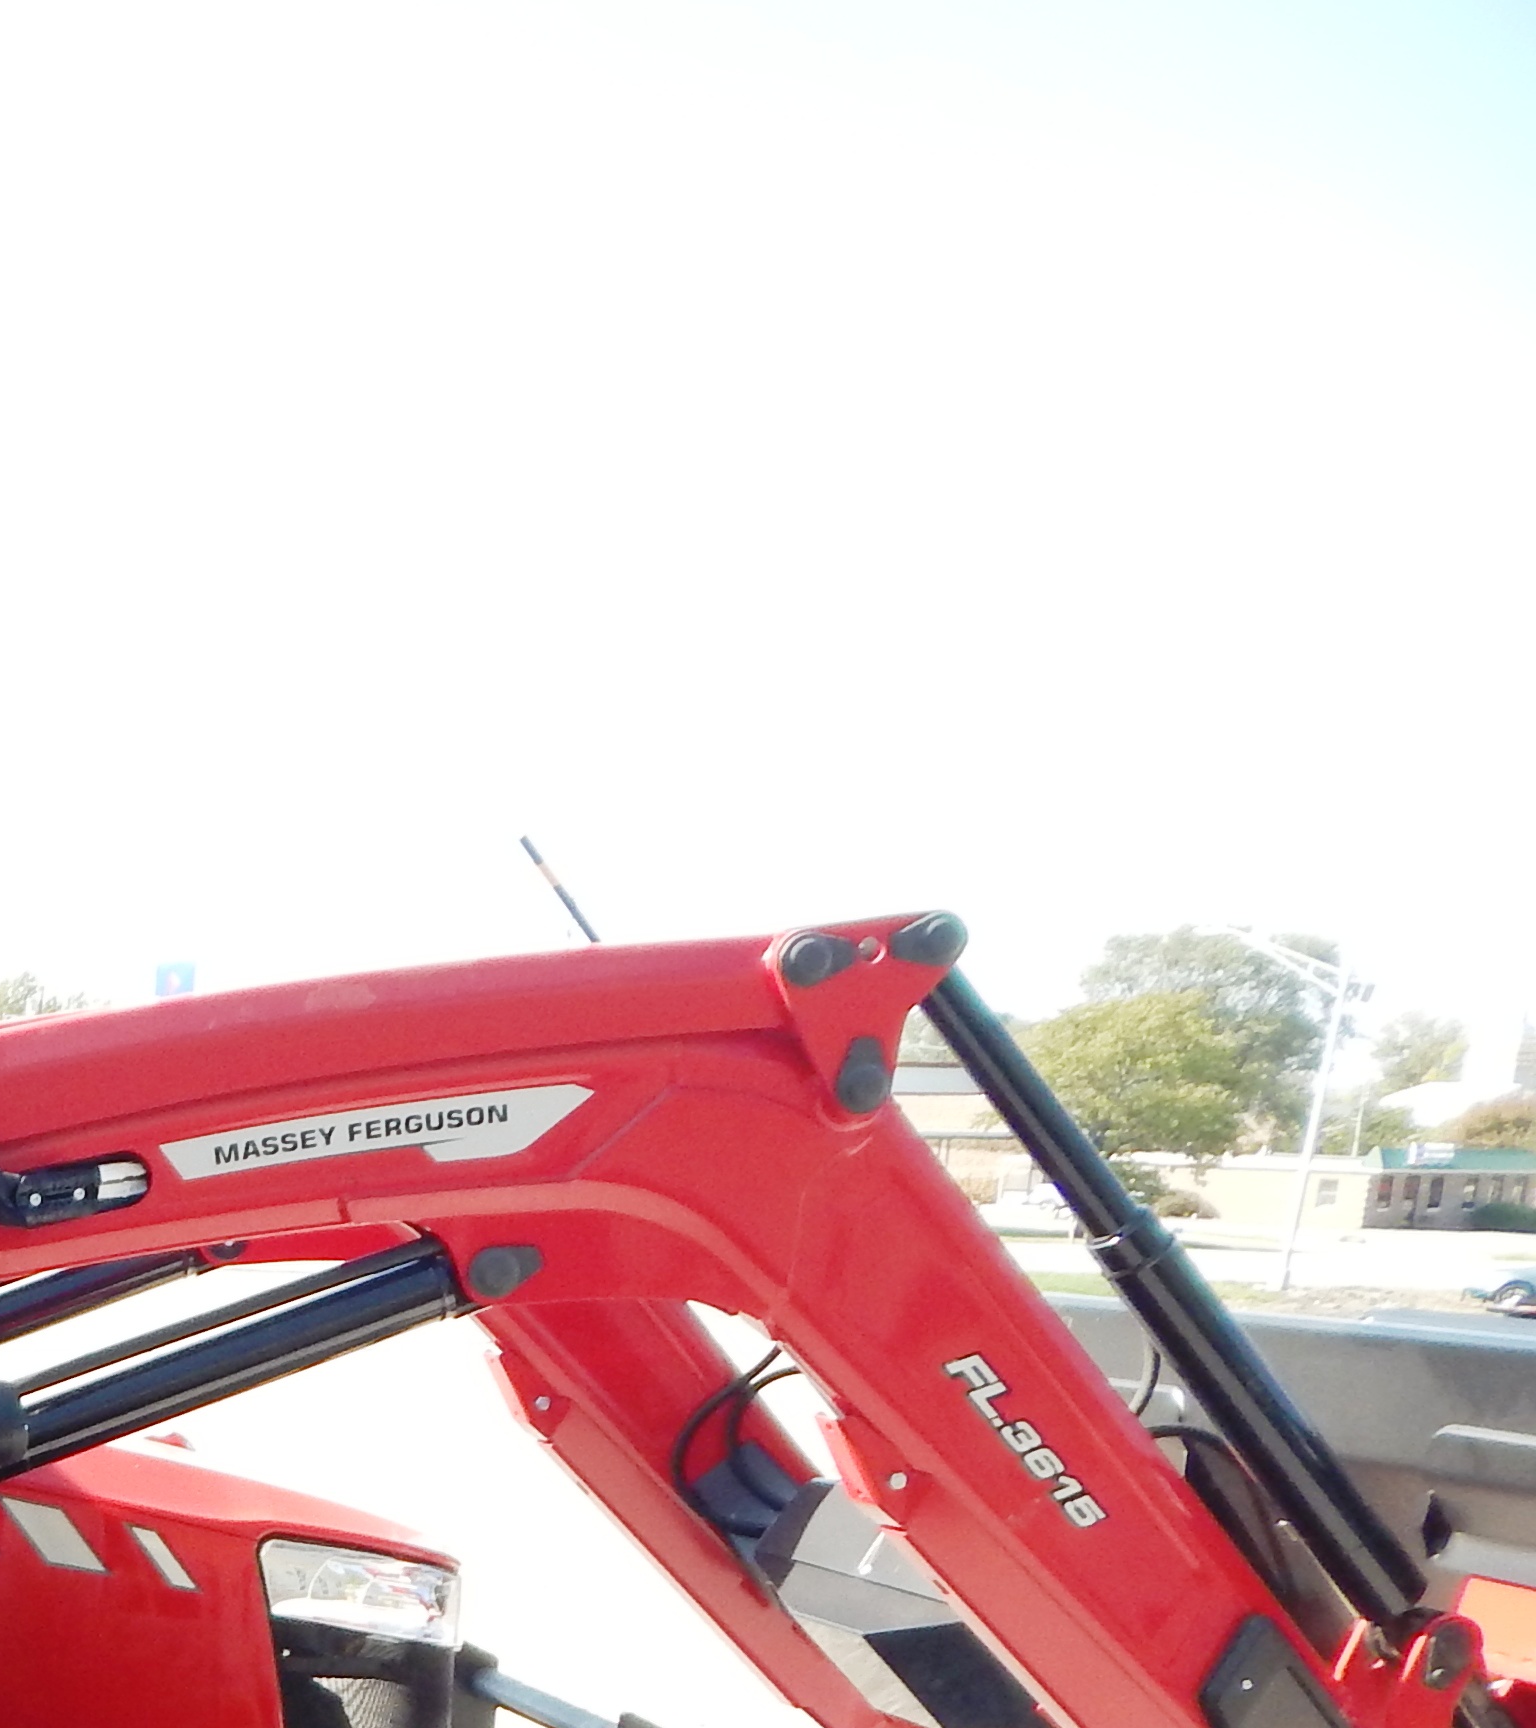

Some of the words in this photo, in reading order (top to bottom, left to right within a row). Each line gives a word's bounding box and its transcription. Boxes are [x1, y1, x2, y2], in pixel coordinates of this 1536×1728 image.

[213, 1125, 334, 1166] MASSEY
[348, 1103, 509, 1146] FERGUSON
[943, 1352, 1108, 1529] FL.3615
